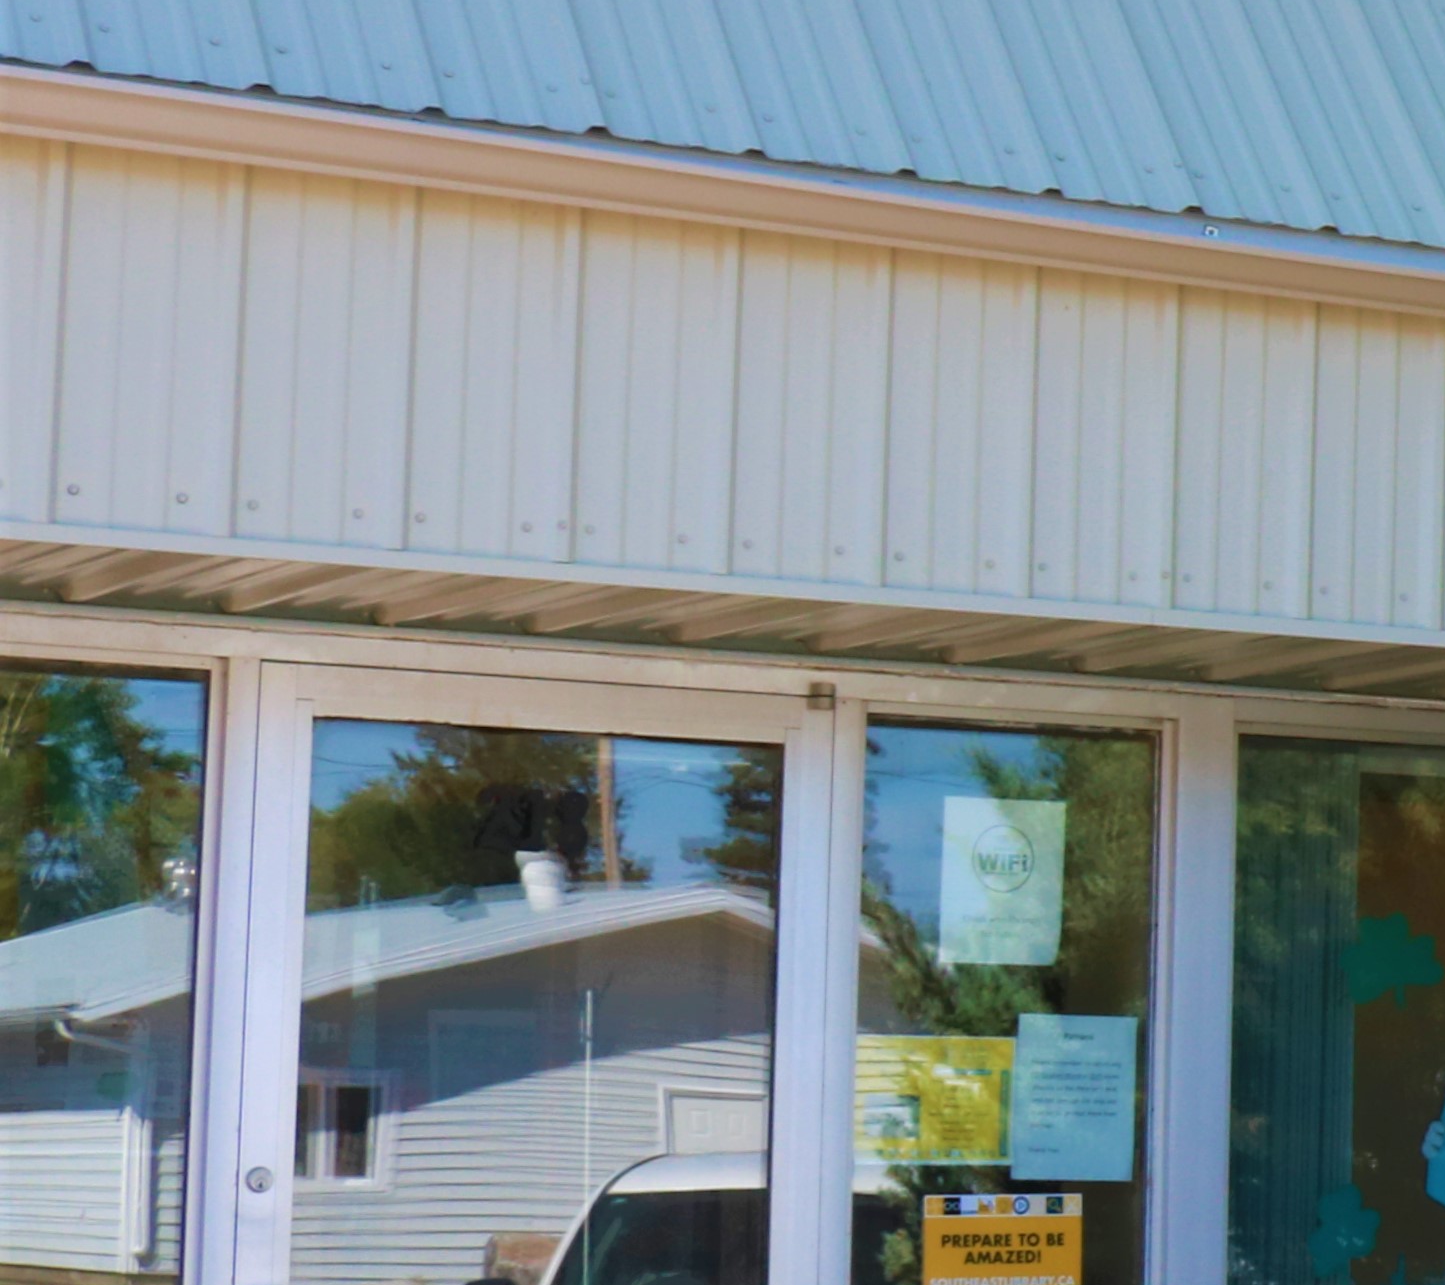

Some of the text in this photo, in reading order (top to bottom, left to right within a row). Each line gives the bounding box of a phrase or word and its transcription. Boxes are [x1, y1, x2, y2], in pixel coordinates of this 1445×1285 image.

[941, 1233, 1065, 1248] PREPARE TO BE
[964, 1250, 1042, 1264] AMAZED!
